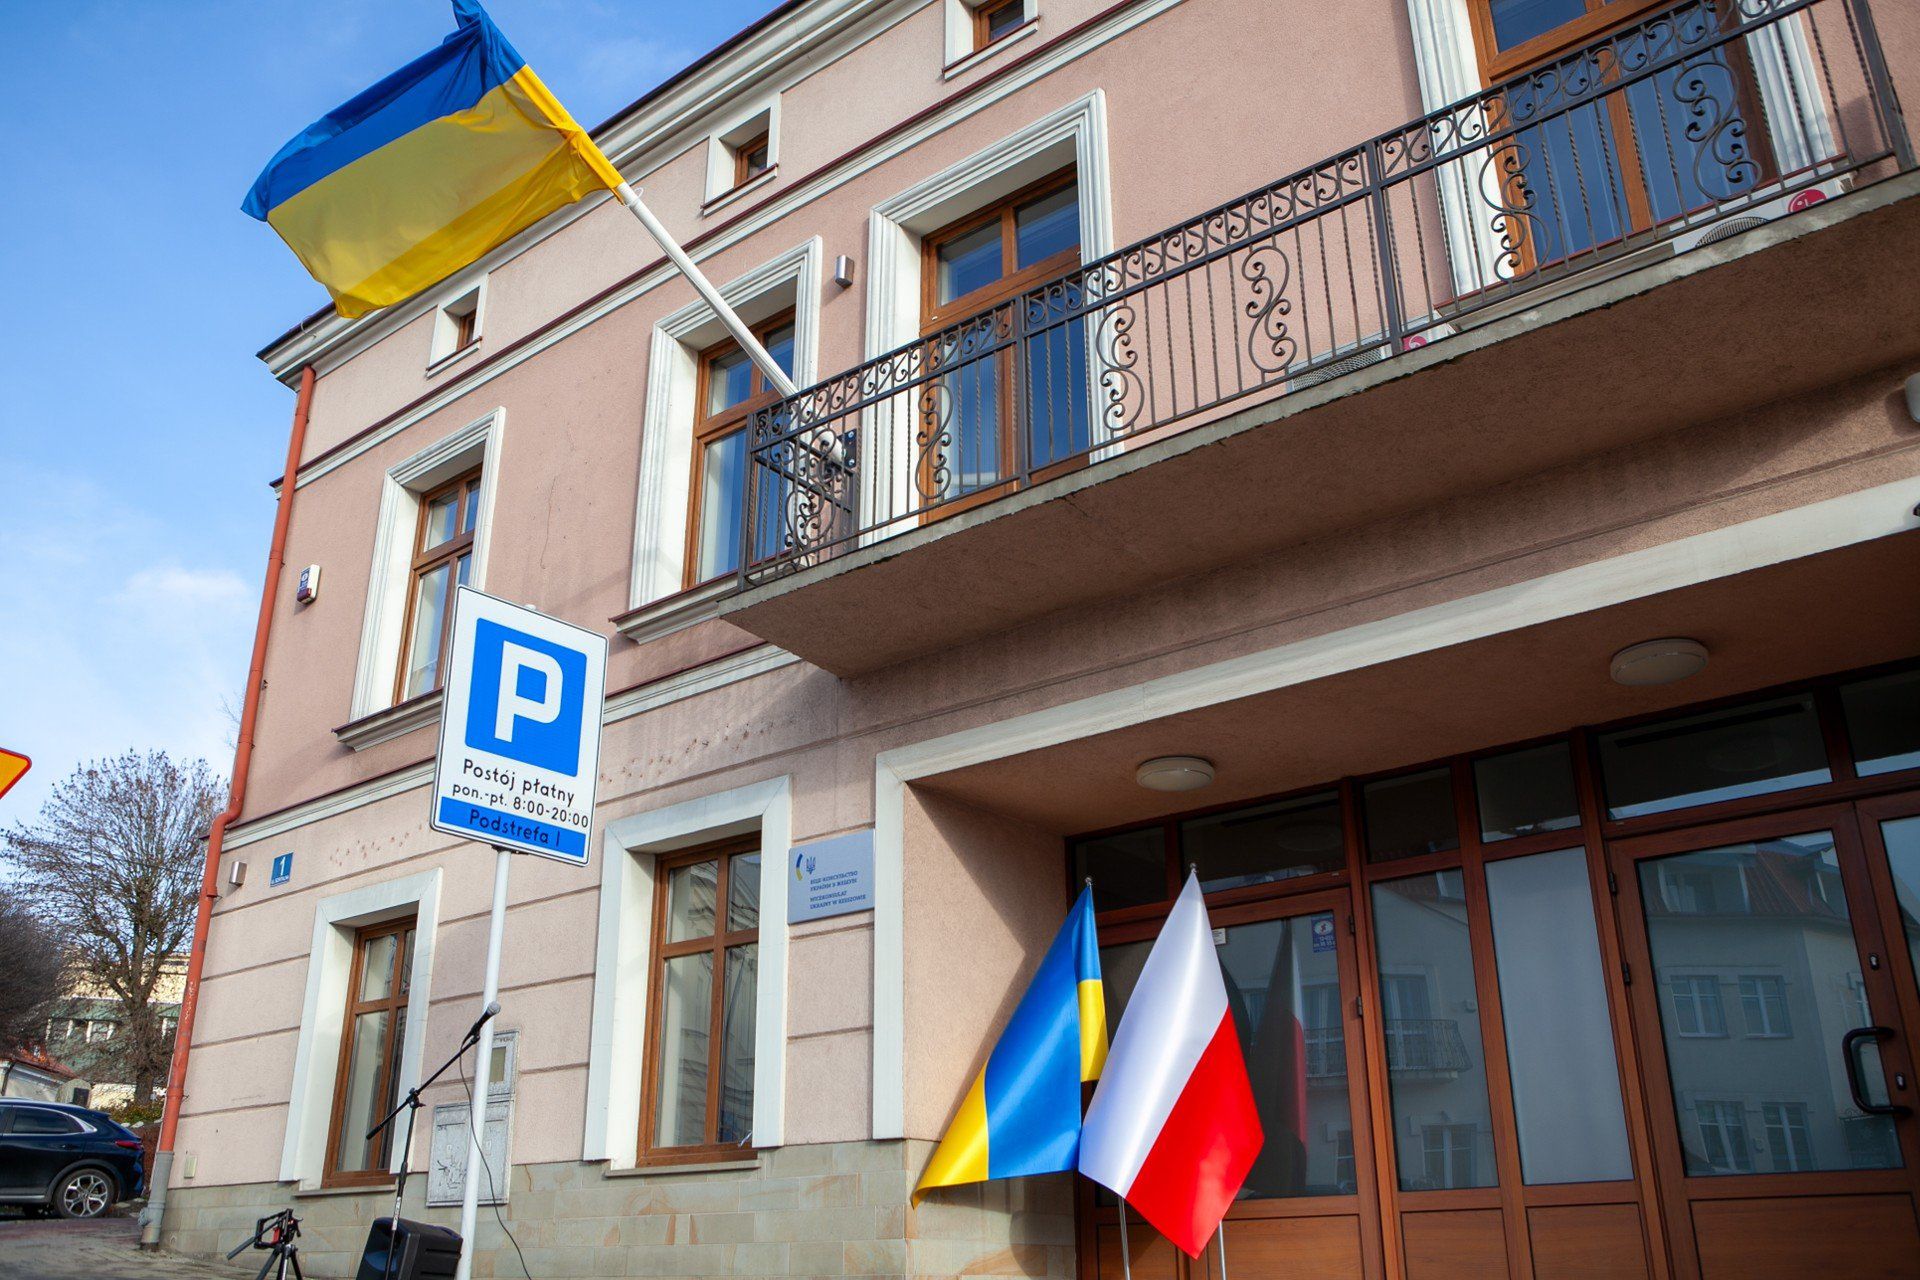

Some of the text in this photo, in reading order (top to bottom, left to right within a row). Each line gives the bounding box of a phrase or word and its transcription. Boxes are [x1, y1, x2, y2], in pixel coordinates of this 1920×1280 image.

[494, 640, 564, 743] P
[452, 783, 590, 828] pon.-pt. 8:00-20:00
[463, 758, 575, 808] Postój płatny
[469, 808, 549, 844] Podstrefa
[279, 856, 286, 876] 1
